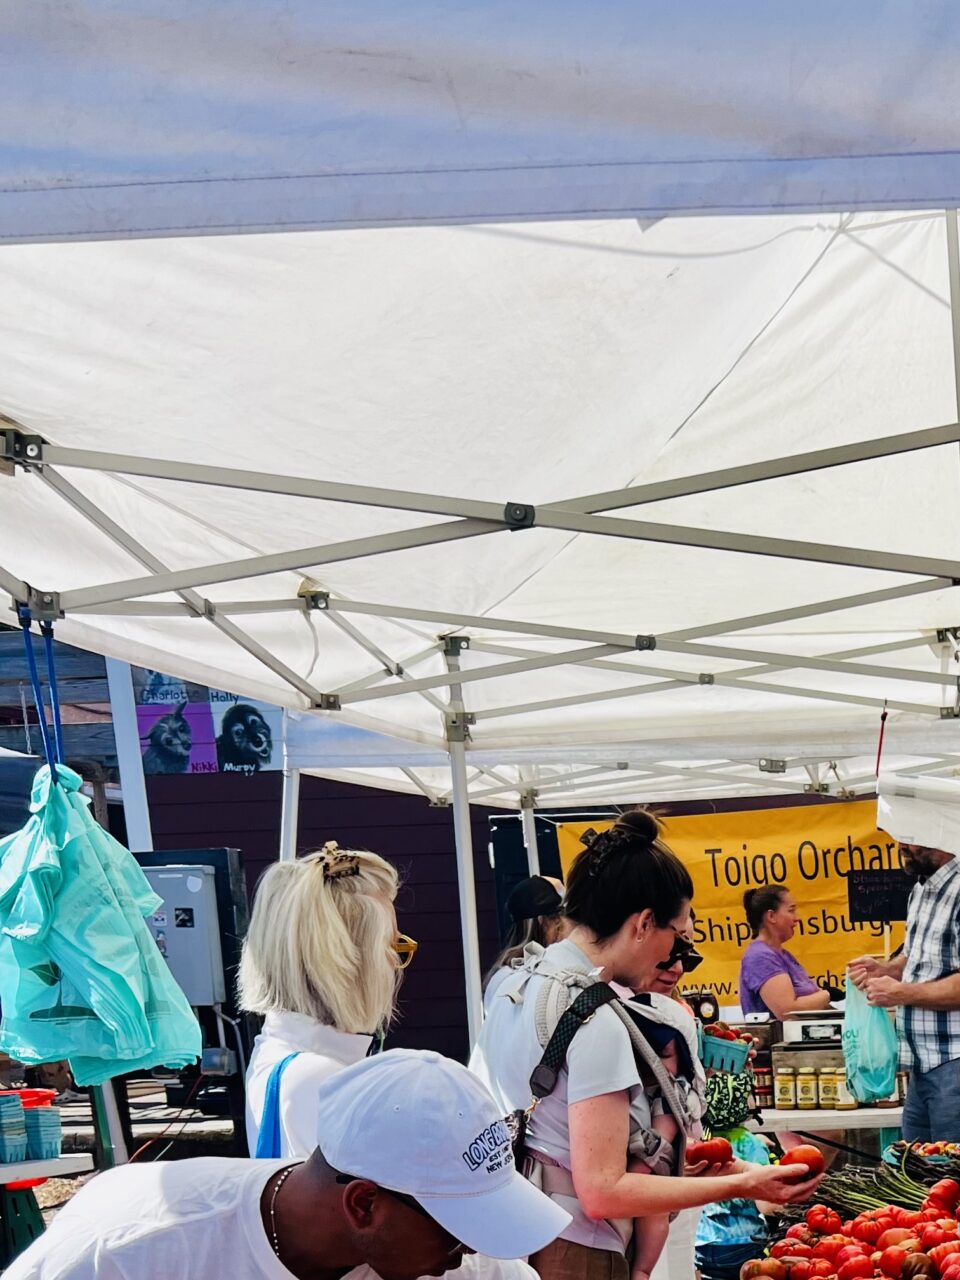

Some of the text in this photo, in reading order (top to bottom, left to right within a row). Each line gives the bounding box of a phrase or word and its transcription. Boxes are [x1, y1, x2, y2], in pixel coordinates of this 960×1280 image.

[211, 691, 240, 704] Holly
[191, 761, 218, 773] Nikki
[704, 843, 788, 887] Toigo
[462, 1128, 497, 1171] LONG
[486, 1160, 503, 1174] NEW
